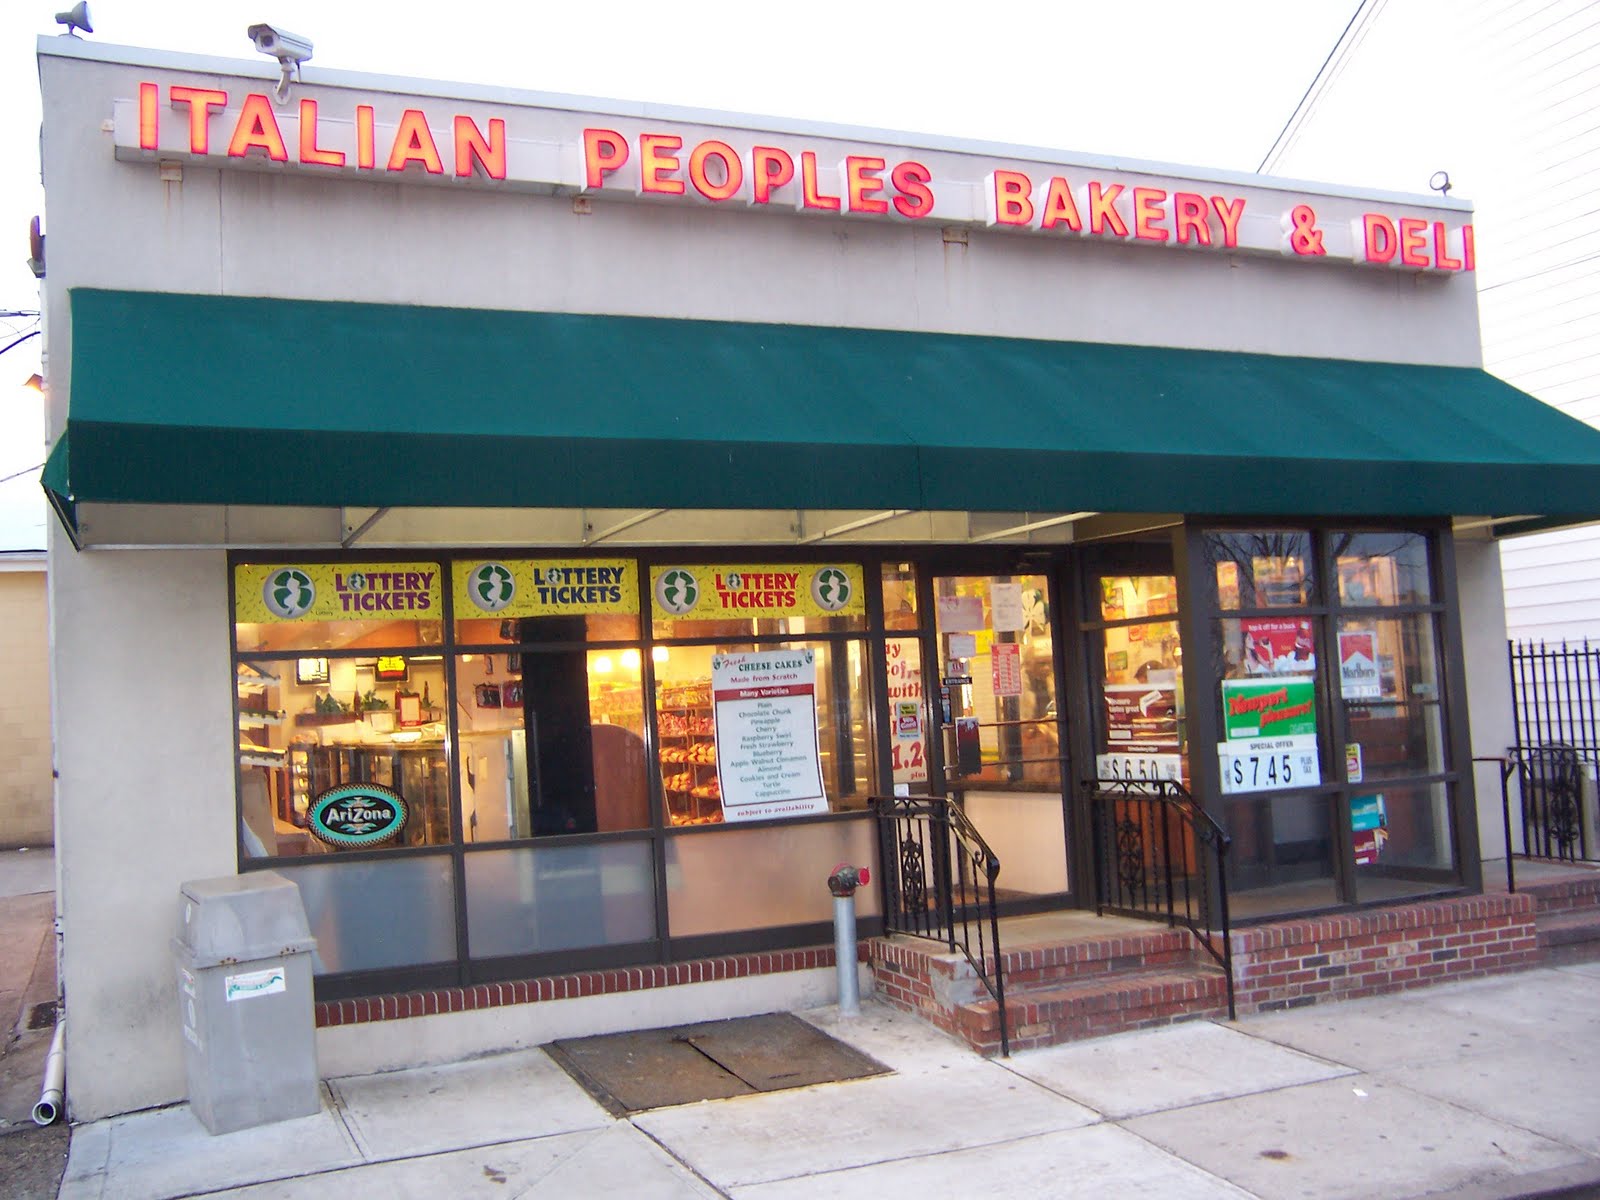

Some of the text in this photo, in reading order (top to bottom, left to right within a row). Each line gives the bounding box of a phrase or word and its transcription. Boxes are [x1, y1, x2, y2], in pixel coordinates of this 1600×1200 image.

[139, 82, 1475, 271] ITALIAN PEOPLES BAKERY & DELI
[335, 571, 435, 592] LOTTERY
[533, 566, 625, 586] LOTTERY
[715, 572, 800, 591] LOTTERY
[339, 591, 431, 612] TICKETS
[537, 585, 622, 605] TICKETS
[719, 591, 797, 609] TICKETS
[722, 655, 746, 669] Fresh
[738, 659, 802, 672] CHEESE CAKES
[1342, 662, 1376, 679] Marlboro
[730, 676, 749, 684] Made
[740, 687, 789, 698] Many Varieties
[887, 682, 923, 698] with
[757, 701, 772, 709] Plain
[1228, 686, 1288, 716] Newport
[738, 708, 792, 719] Chocolate Chunk
[750, 718, 780, 726] Pineapple
[741, 734, 774, 742] Raspberry
[758, 740, 794, 749] Strawberry
[1250, 740, 1293, 750] SPECIAL OFFER
[752, 749, 783, 757] Blueberry
[730, 755, 807, 768] Apple Walnut Cinnamon
[1300, 756, 1313, 764] PLUS
[757, 765, 782, 773] Almond
[1233, 754, 1292, 787] $7.45
[740, 774, 765, 783] Cookies
[780, 771, 800, 779] Cream
[754, 789, 791, 798] Cappuccino
[325, 806, 393, 826] AriZona
[737, 808, 762, 817] subject
[774, 803, 815, 813] availability
